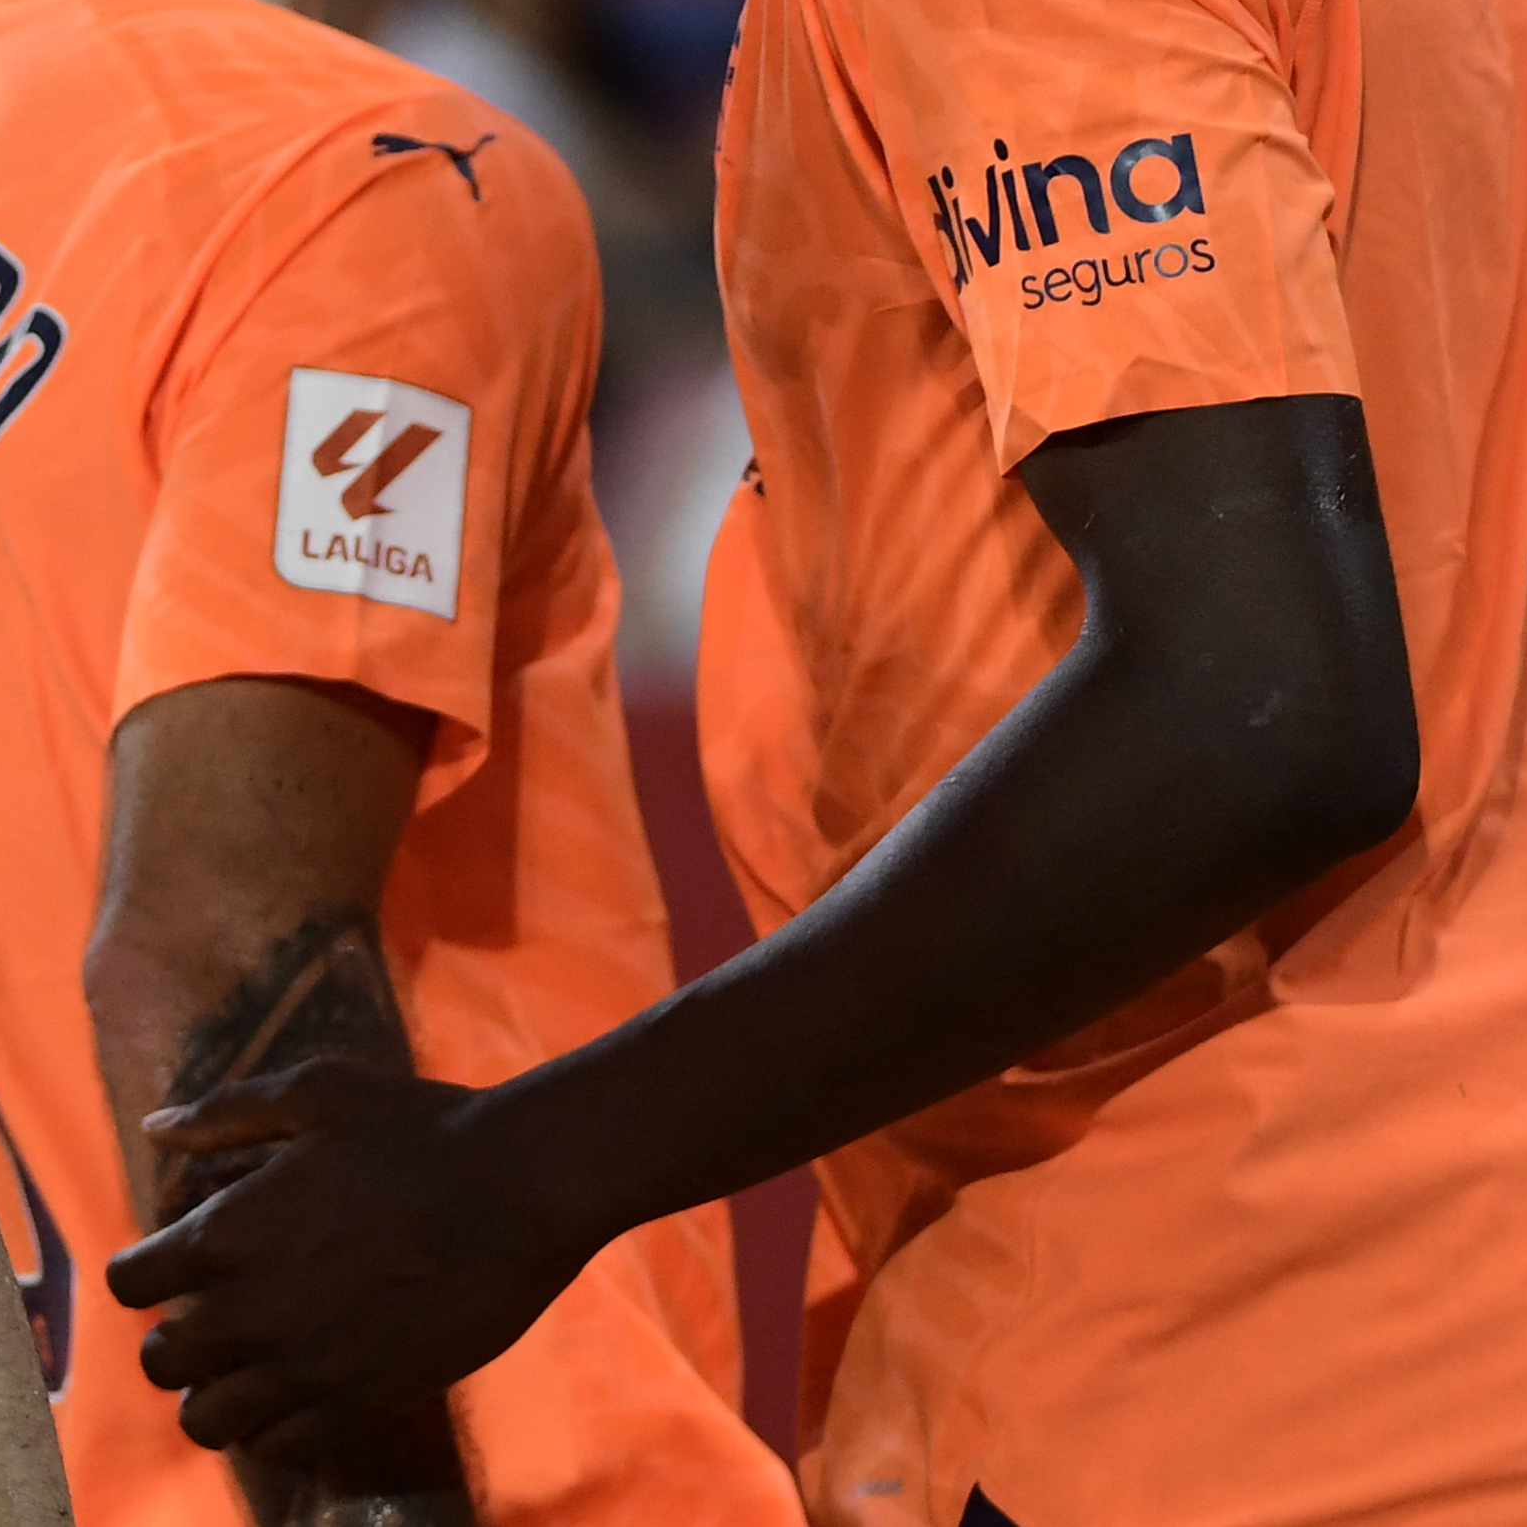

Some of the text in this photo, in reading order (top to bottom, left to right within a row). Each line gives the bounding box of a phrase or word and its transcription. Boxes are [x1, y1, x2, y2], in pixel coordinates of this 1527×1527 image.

[927, 133, 1206, 297] divina
[1021, 239, 1215, 309] seguros
[301, 529, 434, 583] LALIGA
